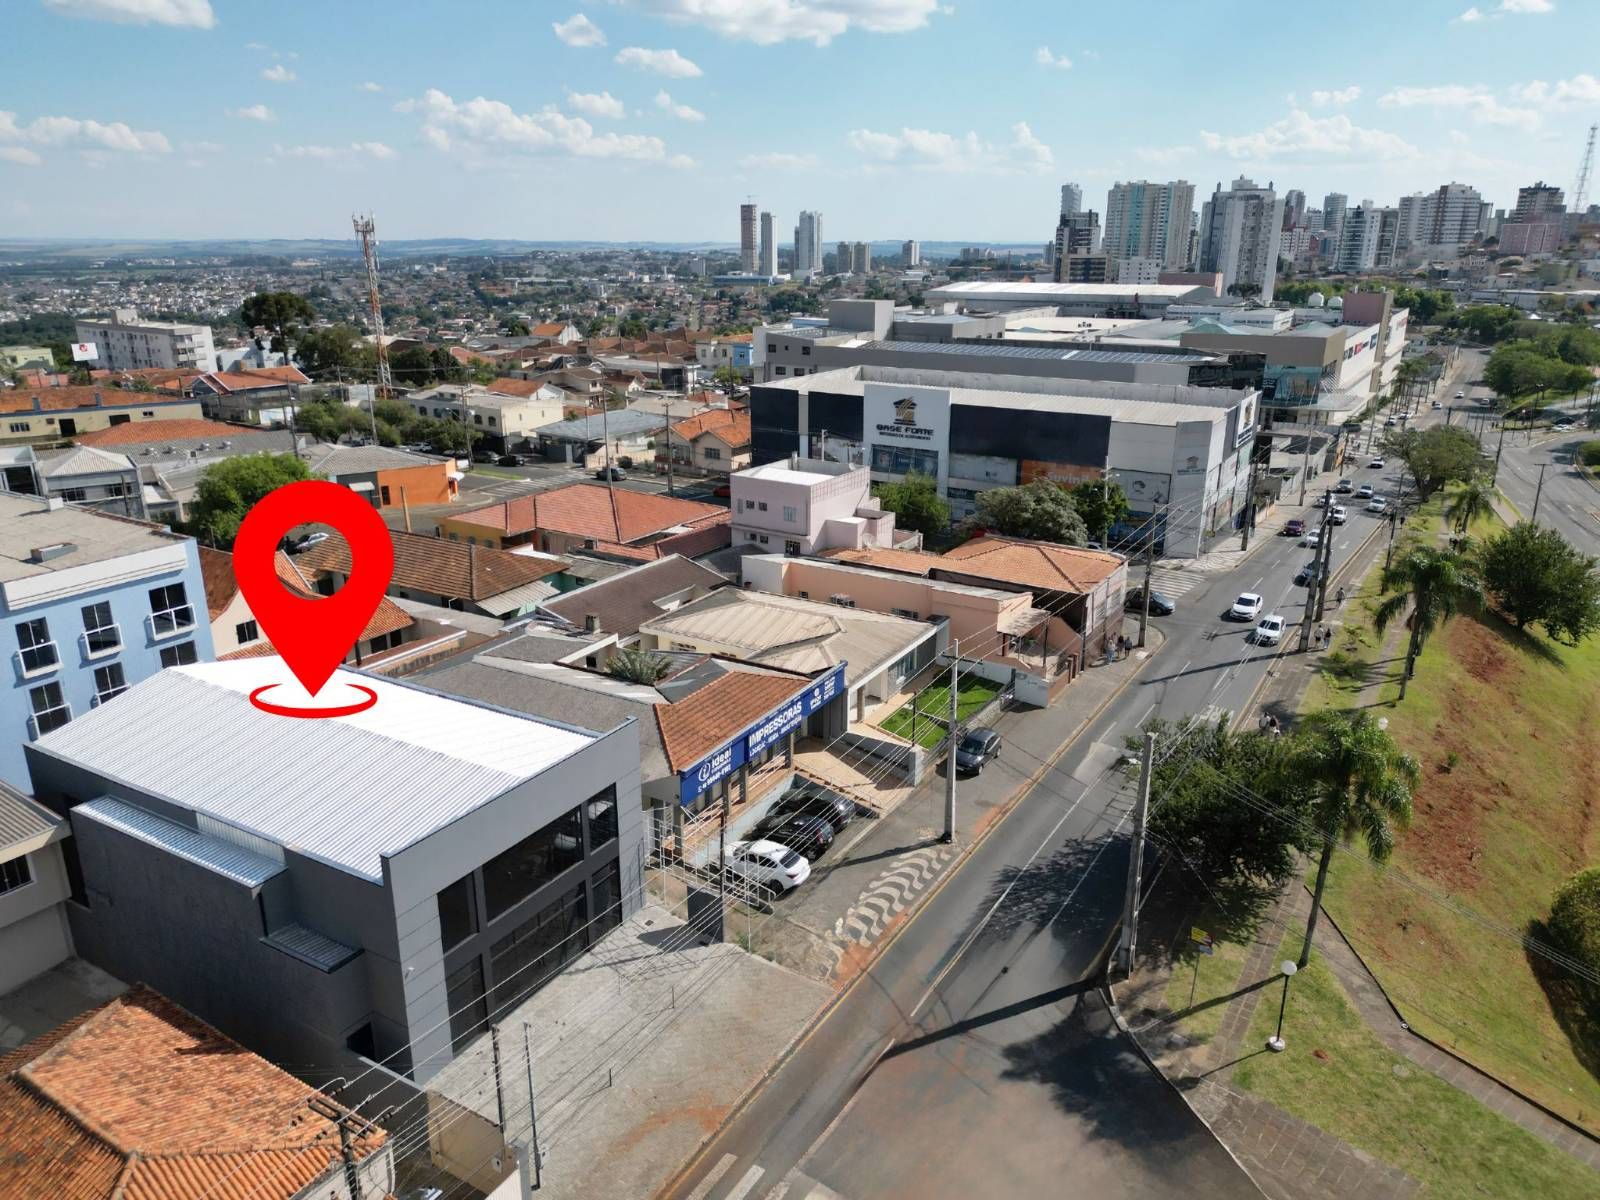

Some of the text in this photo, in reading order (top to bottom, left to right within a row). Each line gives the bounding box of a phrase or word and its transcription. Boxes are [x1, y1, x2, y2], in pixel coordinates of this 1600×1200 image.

[876, 424, 902, 432] BASE
[905, 426, 934, 436] FORTE
[749, 701, 802, 747] IMPRESSORAS
